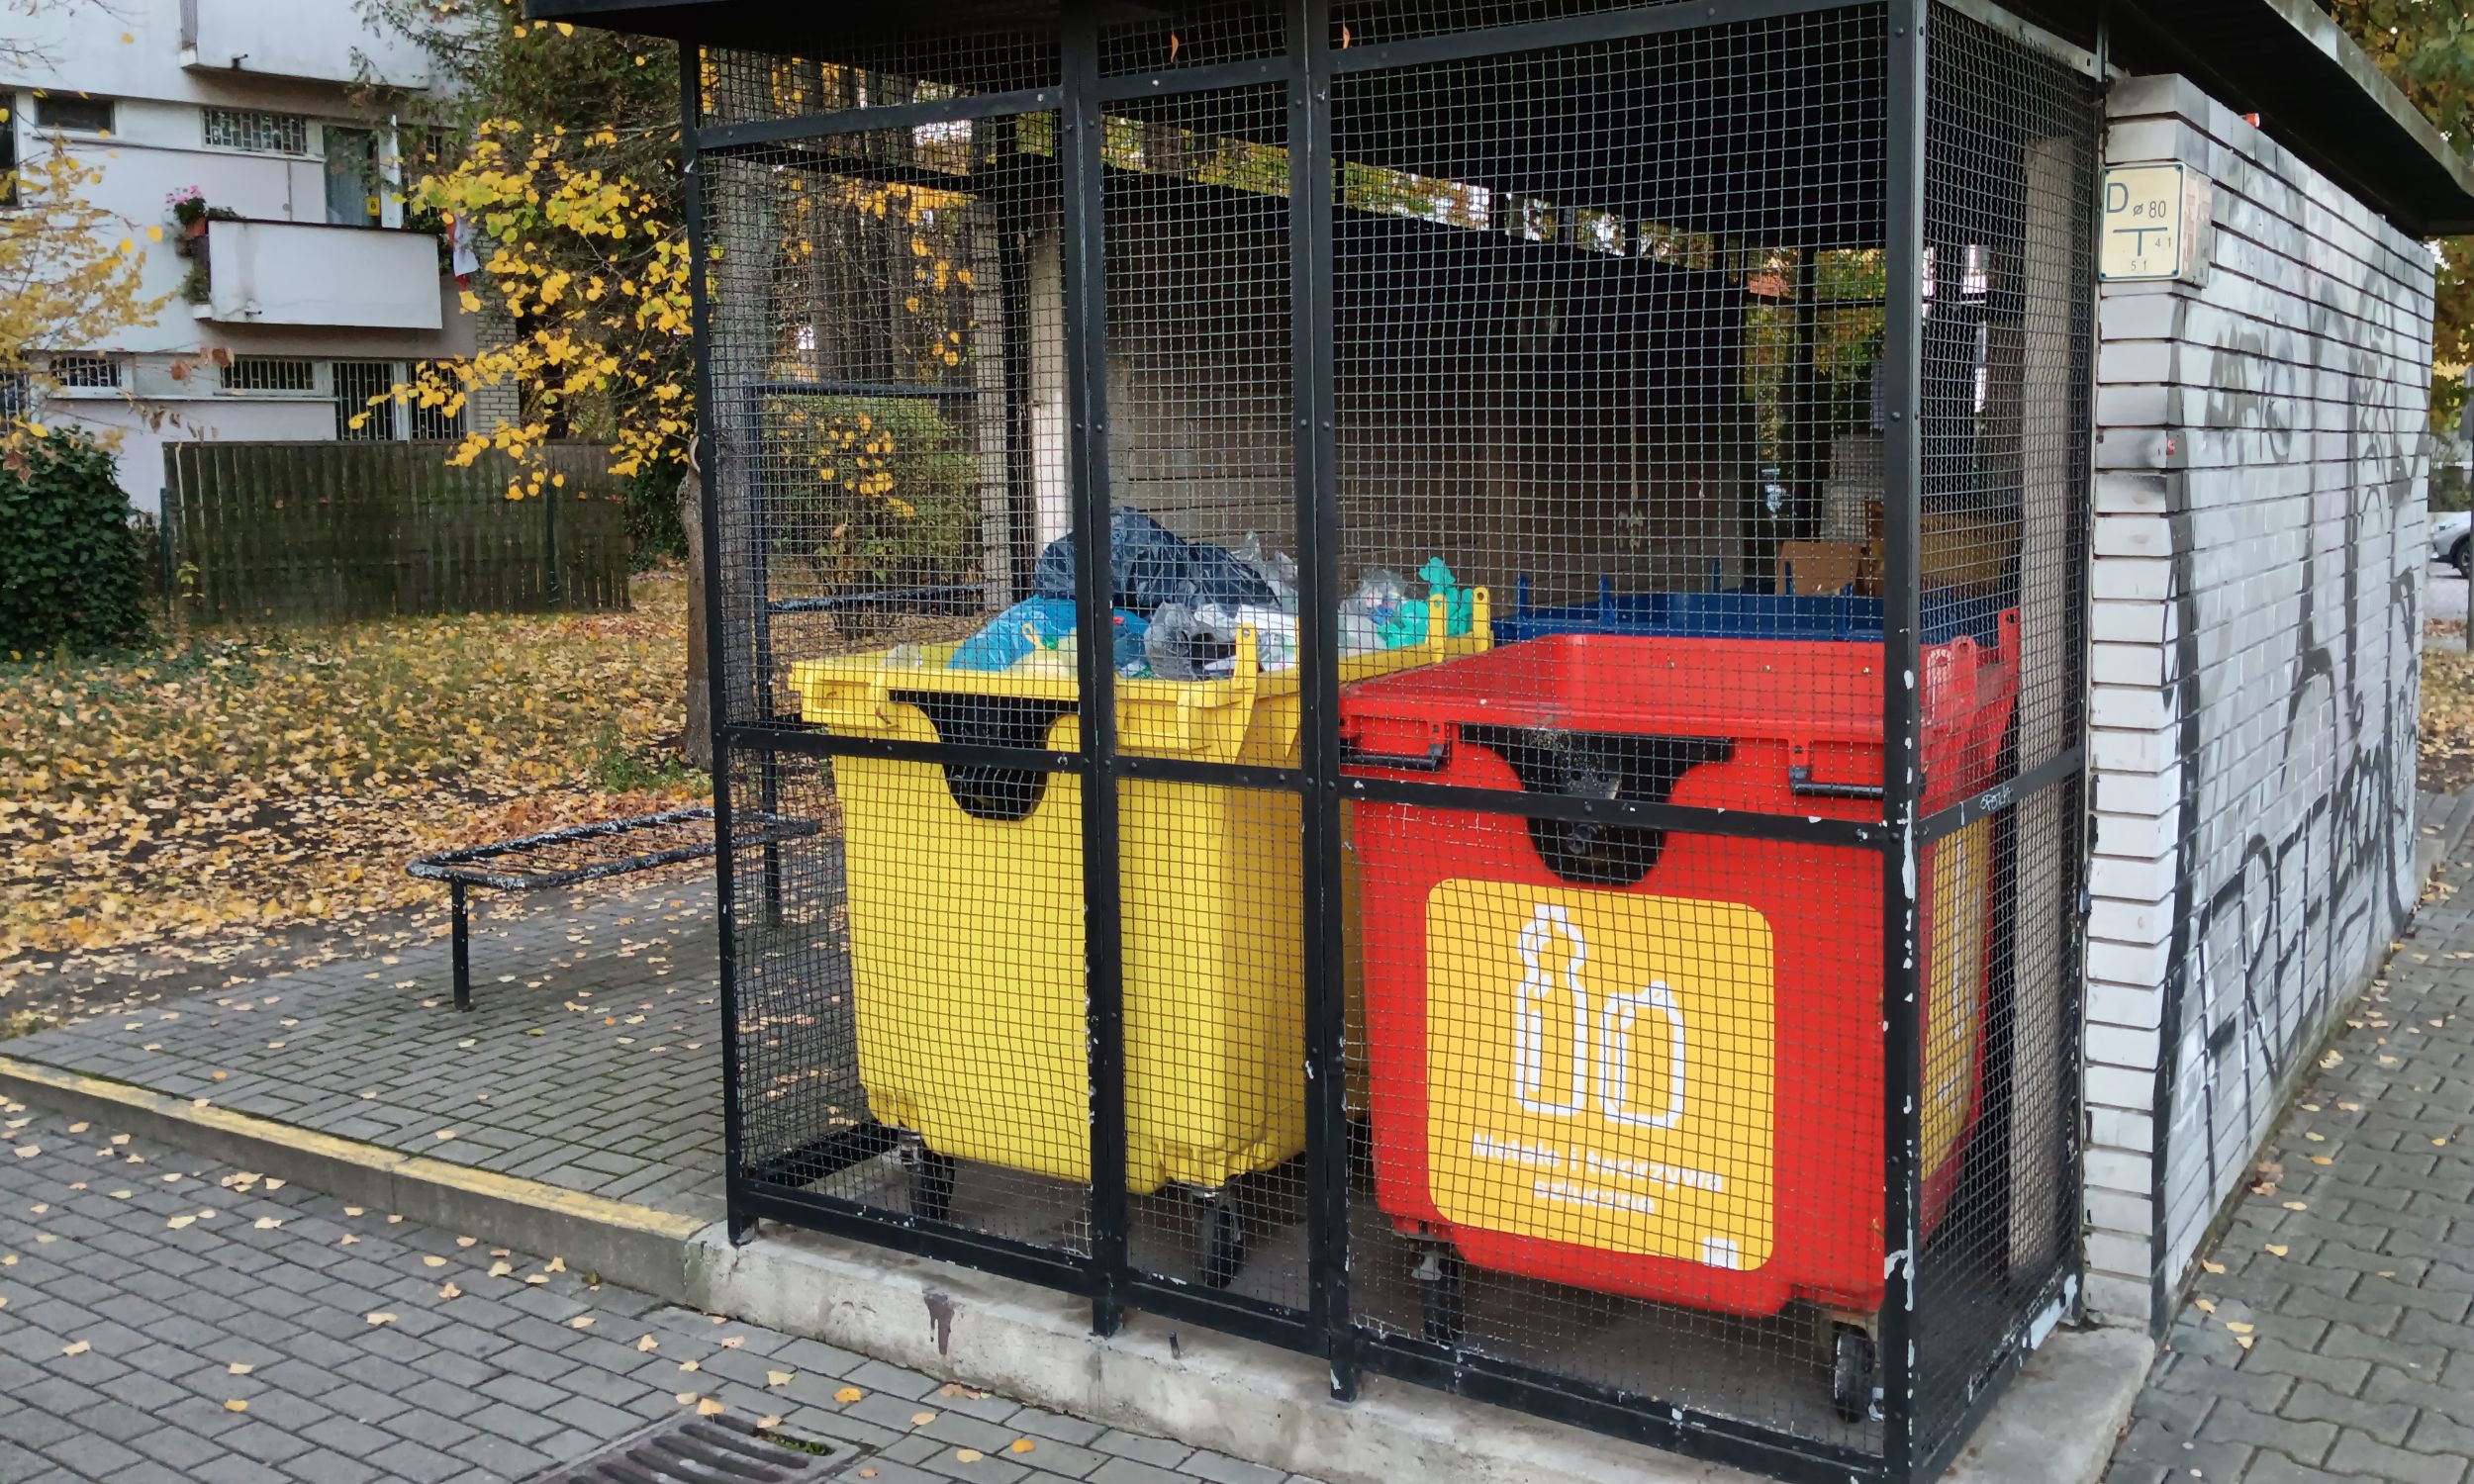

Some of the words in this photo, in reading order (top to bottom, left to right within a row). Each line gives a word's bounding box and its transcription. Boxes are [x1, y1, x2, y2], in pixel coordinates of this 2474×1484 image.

[2106, 182, 2129, 214] D
[2148, 200, 2166, 219] 80
[1473, 1132, 1561, 1168] Metale
[1570, 1147, 1577, 1171] i
[1585, 1149, 1724, 1192] tworzywa
[1533, 1177, 1656, 1215] sztuczne
